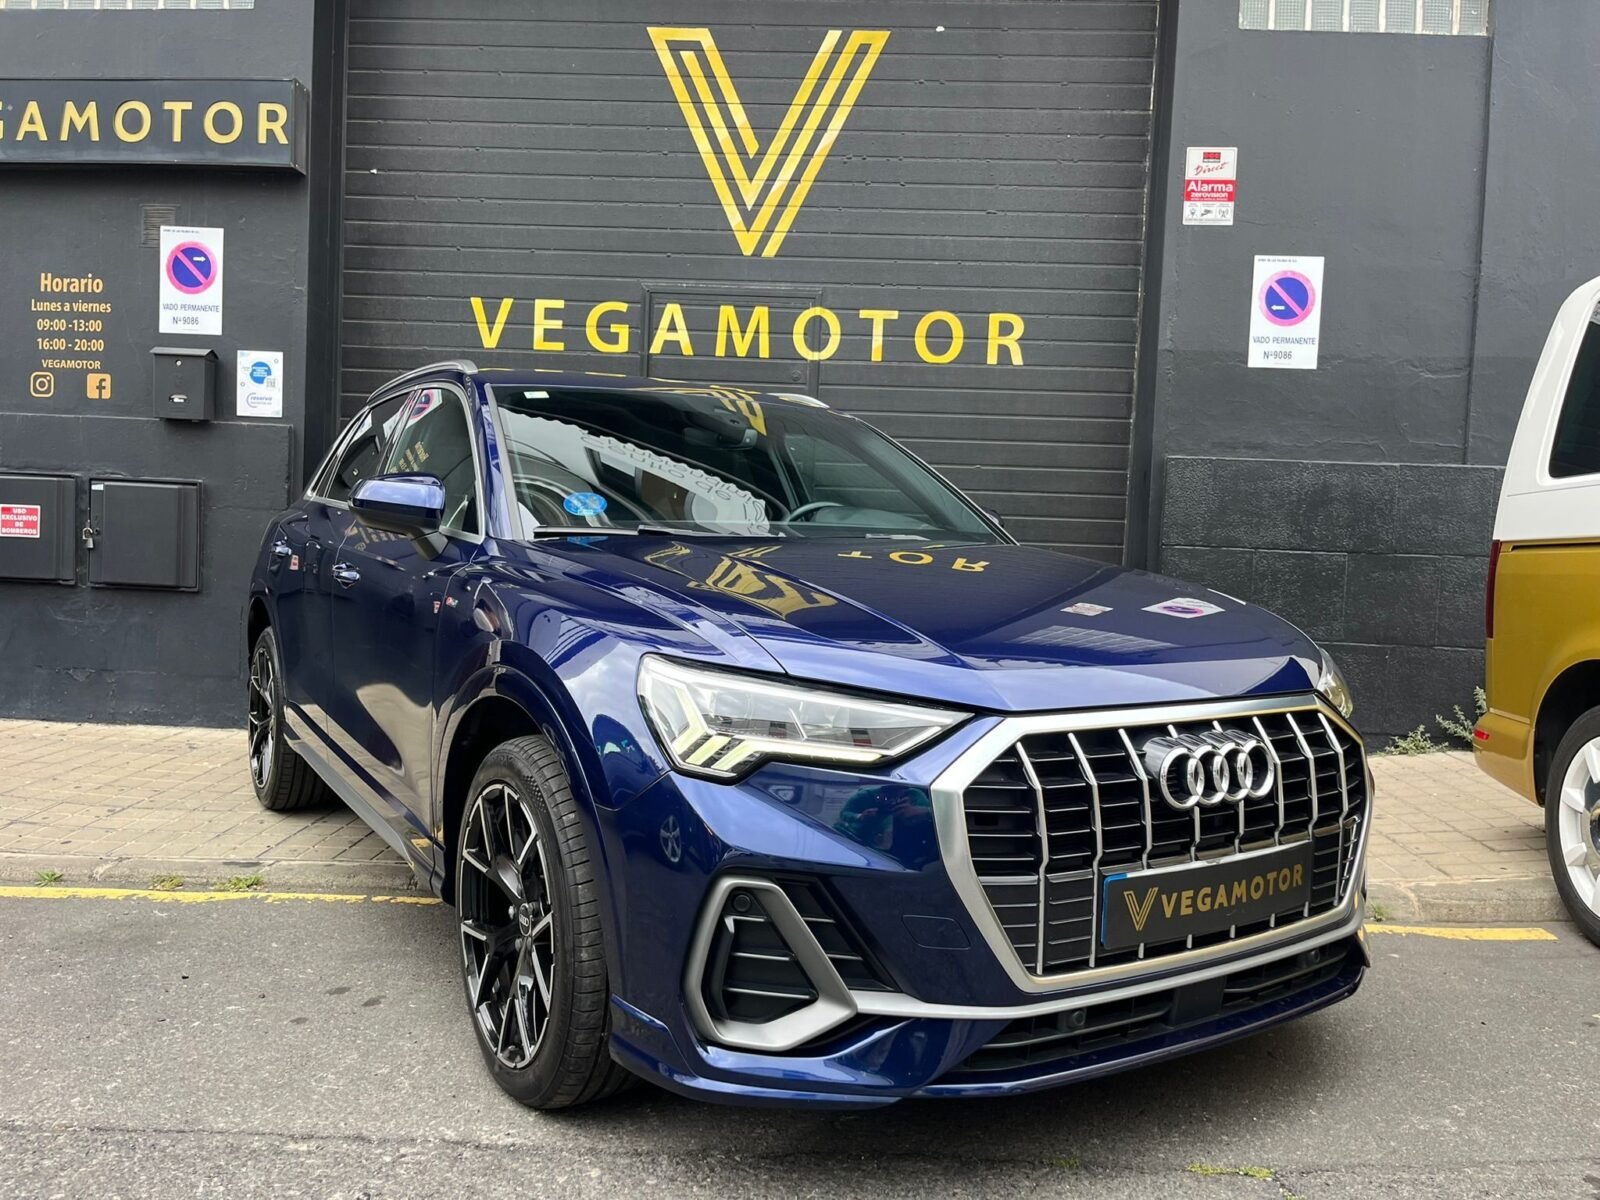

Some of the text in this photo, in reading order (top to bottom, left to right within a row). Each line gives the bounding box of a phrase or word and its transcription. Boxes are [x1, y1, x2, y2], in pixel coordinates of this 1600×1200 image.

[0, 100, 289, 144] AMOTOR
[1187, 181, 1233, 192] Alarma
[40, 273, 103, 293] Horario
[31, 299, 112, 313] Lunes a viernes
[162, 303, 220, 313] VADO PERMANENTE
[36, 318, 66, 331] 09:00
[470, 297, 1024, 366] VEGAMOTOR
[36, 337, 66, 350] 16:00
[74, 339, 104, 352] 20:00
[1252, 336, 1317, 346] VADO PERMANENTE
[41, 359, 101, 370] VEGAMOTOR
[1162, 864, 1302, 918] VEGAMOTOR
